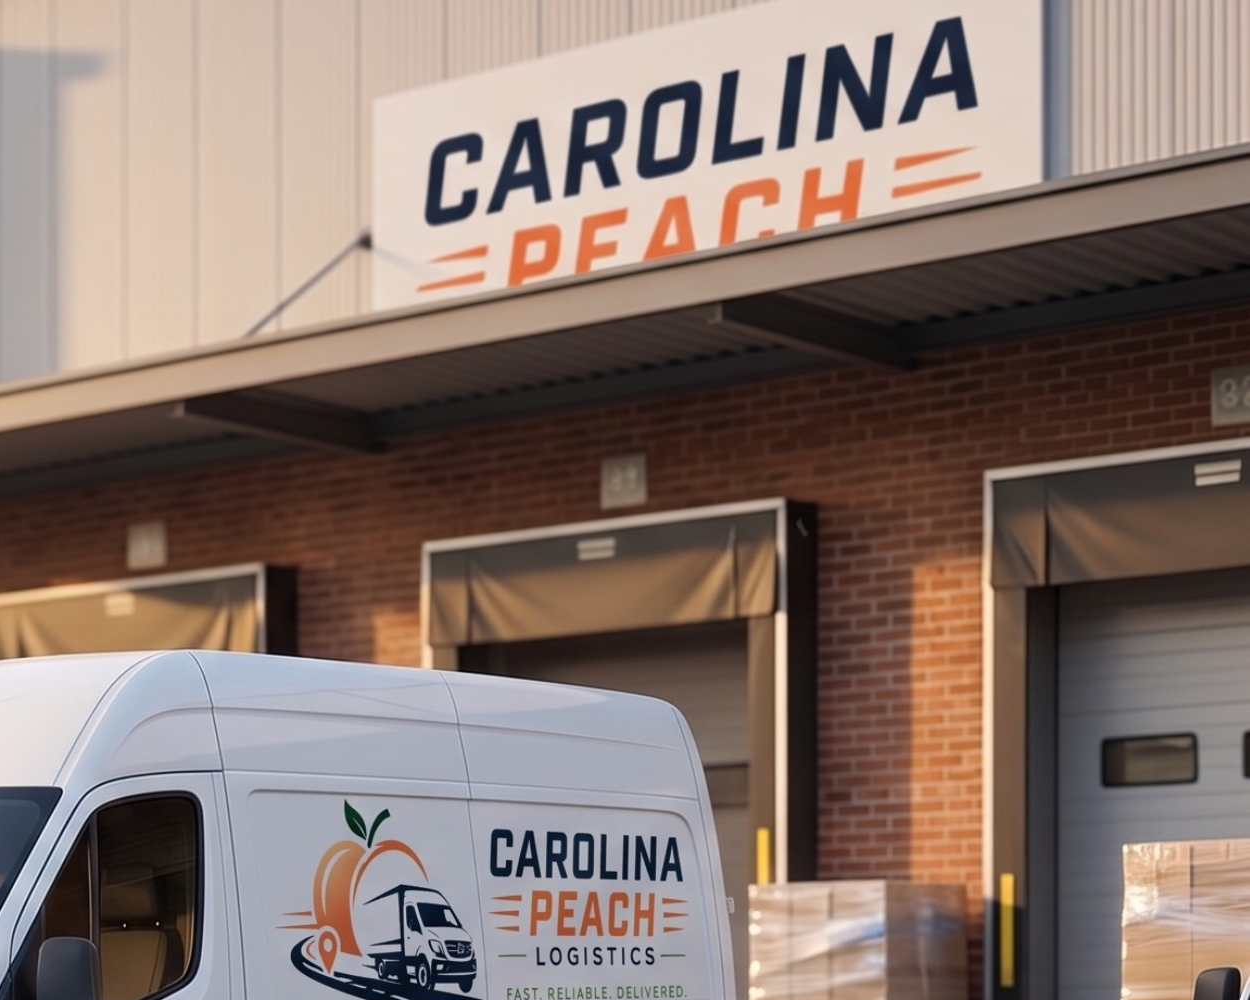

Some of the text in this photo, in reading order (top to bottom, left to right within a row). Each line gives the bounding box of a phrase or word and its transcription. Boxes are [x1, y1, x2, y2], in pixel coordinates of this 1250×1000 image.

[424, 16, 979, 227] CAROLINA
[489, 828, 684, 883] CAROLINA
[529, 889, 656, 938] PEACH
[535, 946, 656, 967] LOGISTICS
[506, 985, 688, 1000] FAST. RELIABLE. DELIVERED.
